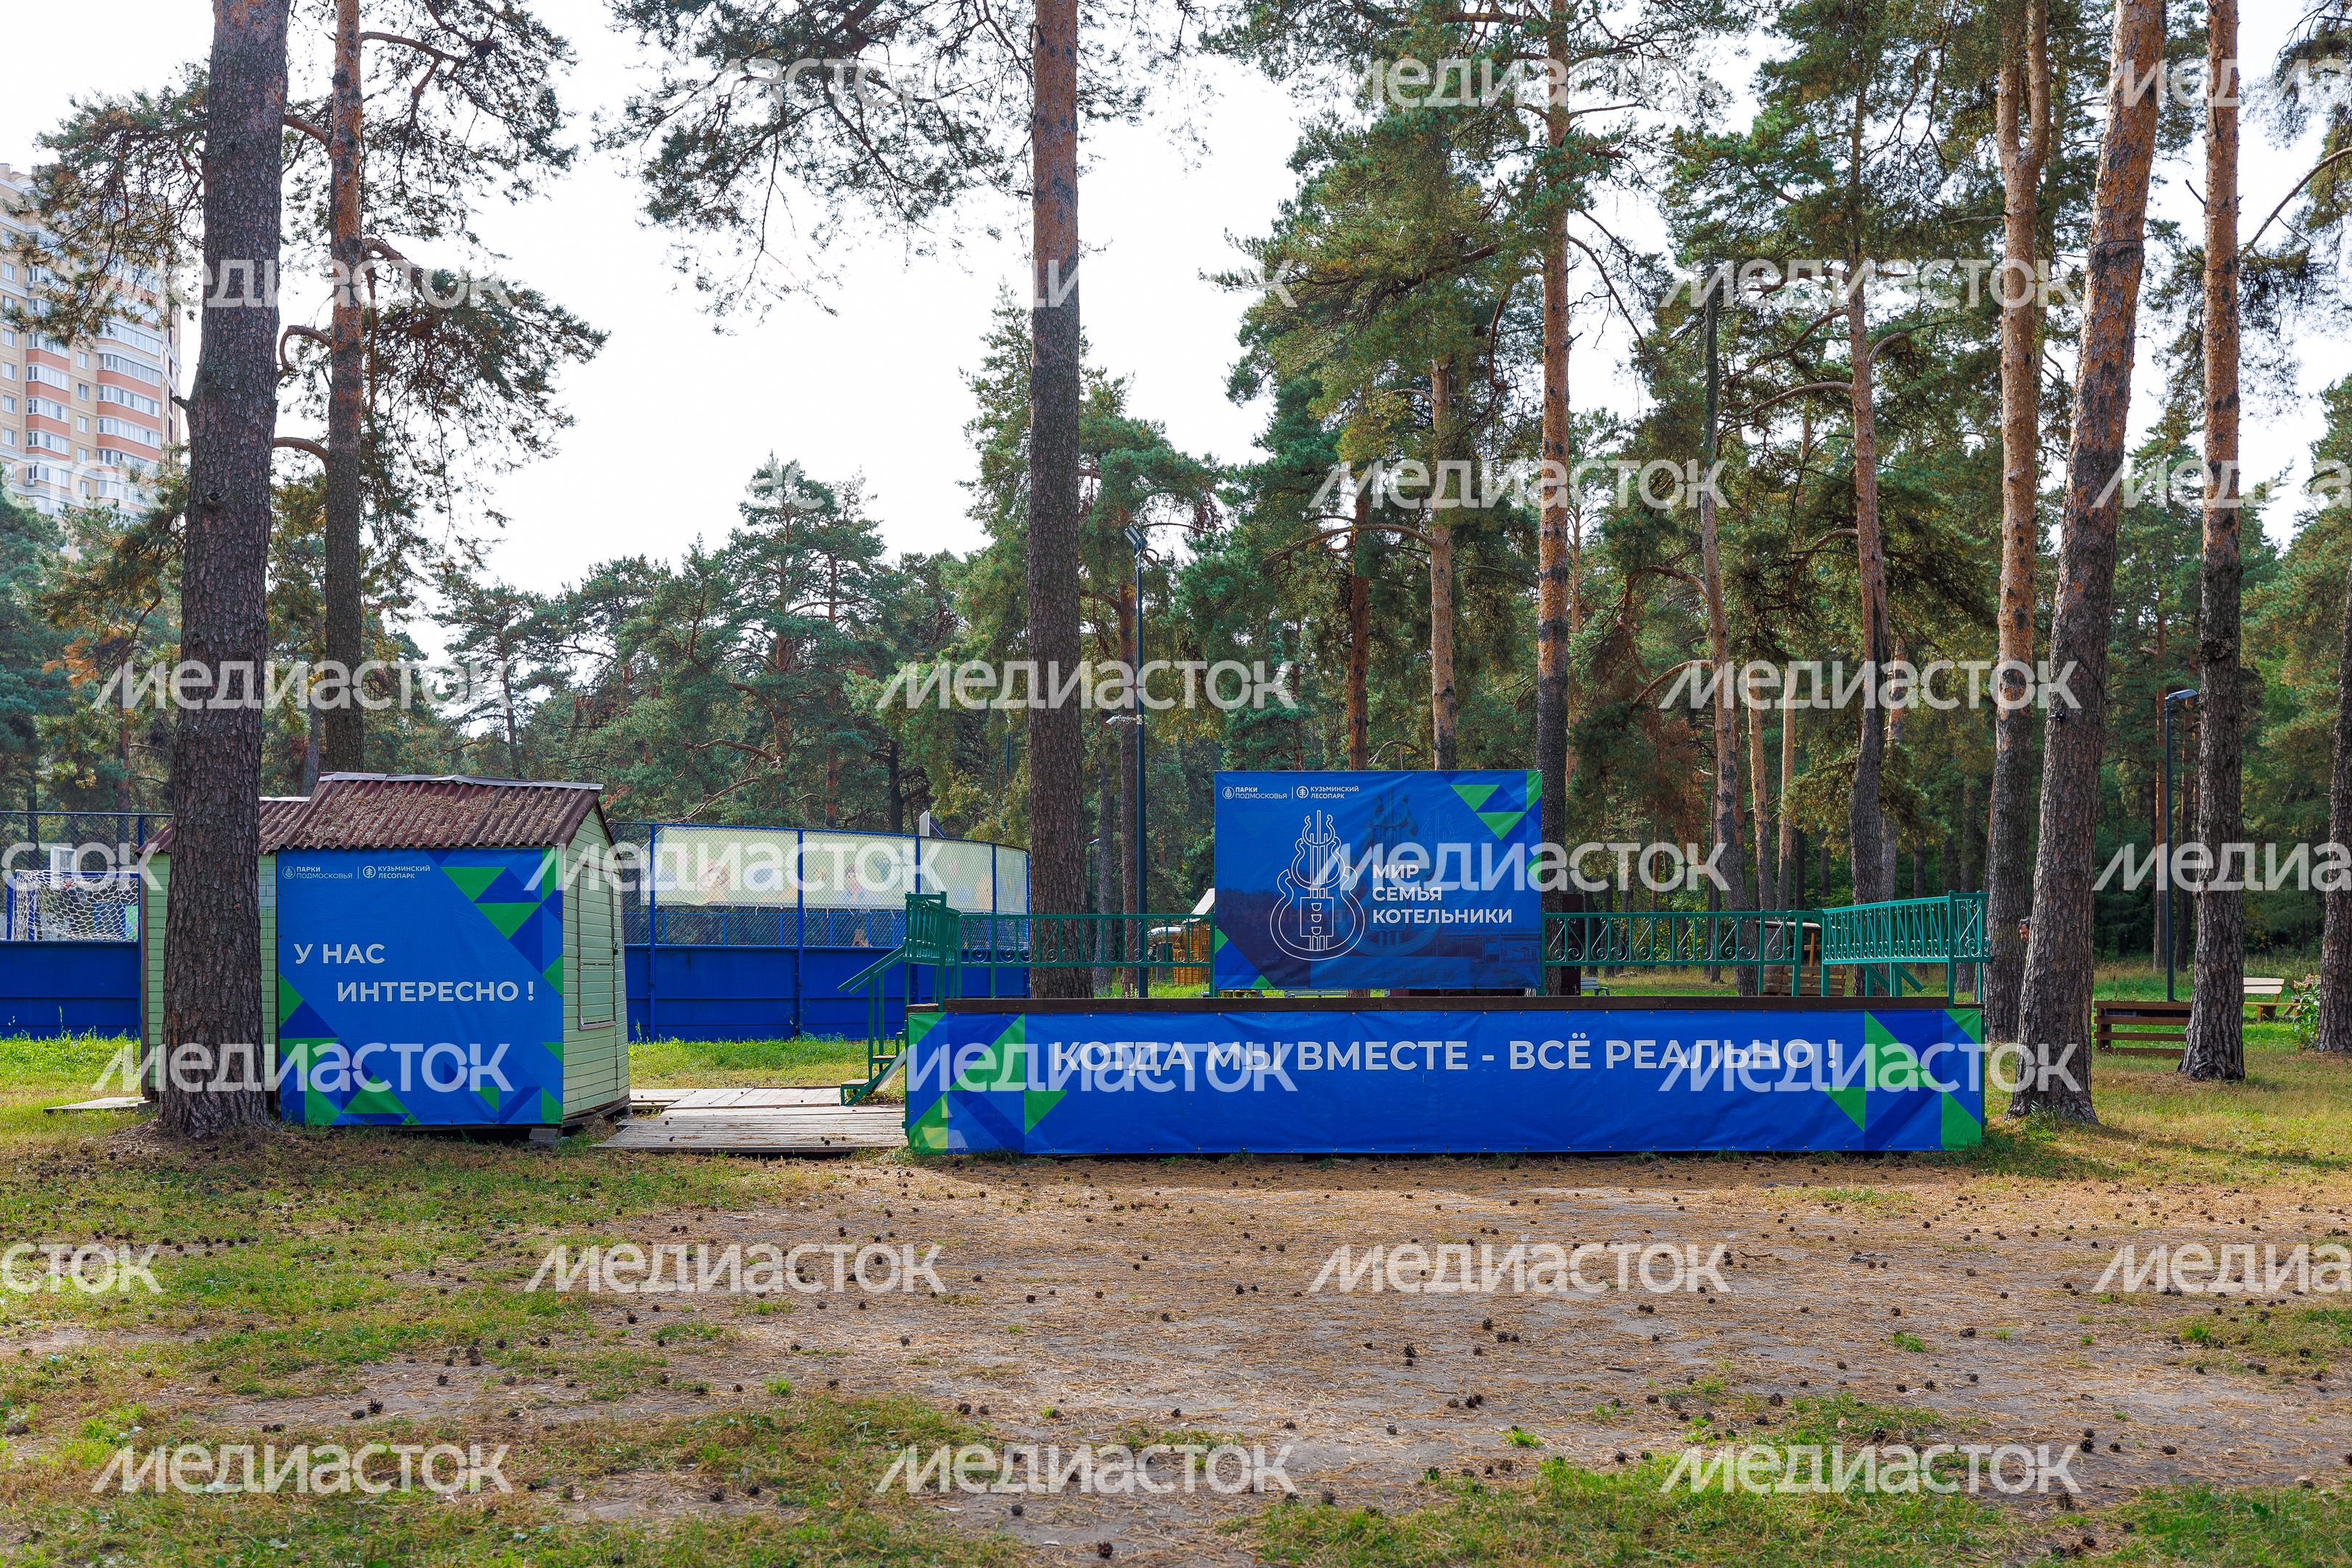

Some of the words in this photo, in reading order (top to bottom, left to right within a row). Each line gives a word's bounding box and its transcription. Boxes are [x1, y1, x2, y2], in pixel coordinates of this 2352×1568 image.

[1373, 864, 1419, 878] МИР
[1372, 886, 1442, 901] СЕМЬЯ
[1373, 908, 1512, 923] КОТЕЛЬНИКИ
[293, 944, 314, 964] У
[323, 944, 385, 964] НАС
[338, 981, 519, 1002] ИНТЕРЕСНО
[1054, 1041, 1193, 1076] КОГДА
[1207, 1041, 1281, 1071] МЫ
[1297, 1040, 1468, 1071] ВМЕСТЕ
[1509, 1032, 1591, 1070] ВСЁ
[1605, 1039, 1814, 1069] РЕАЛЬНО
